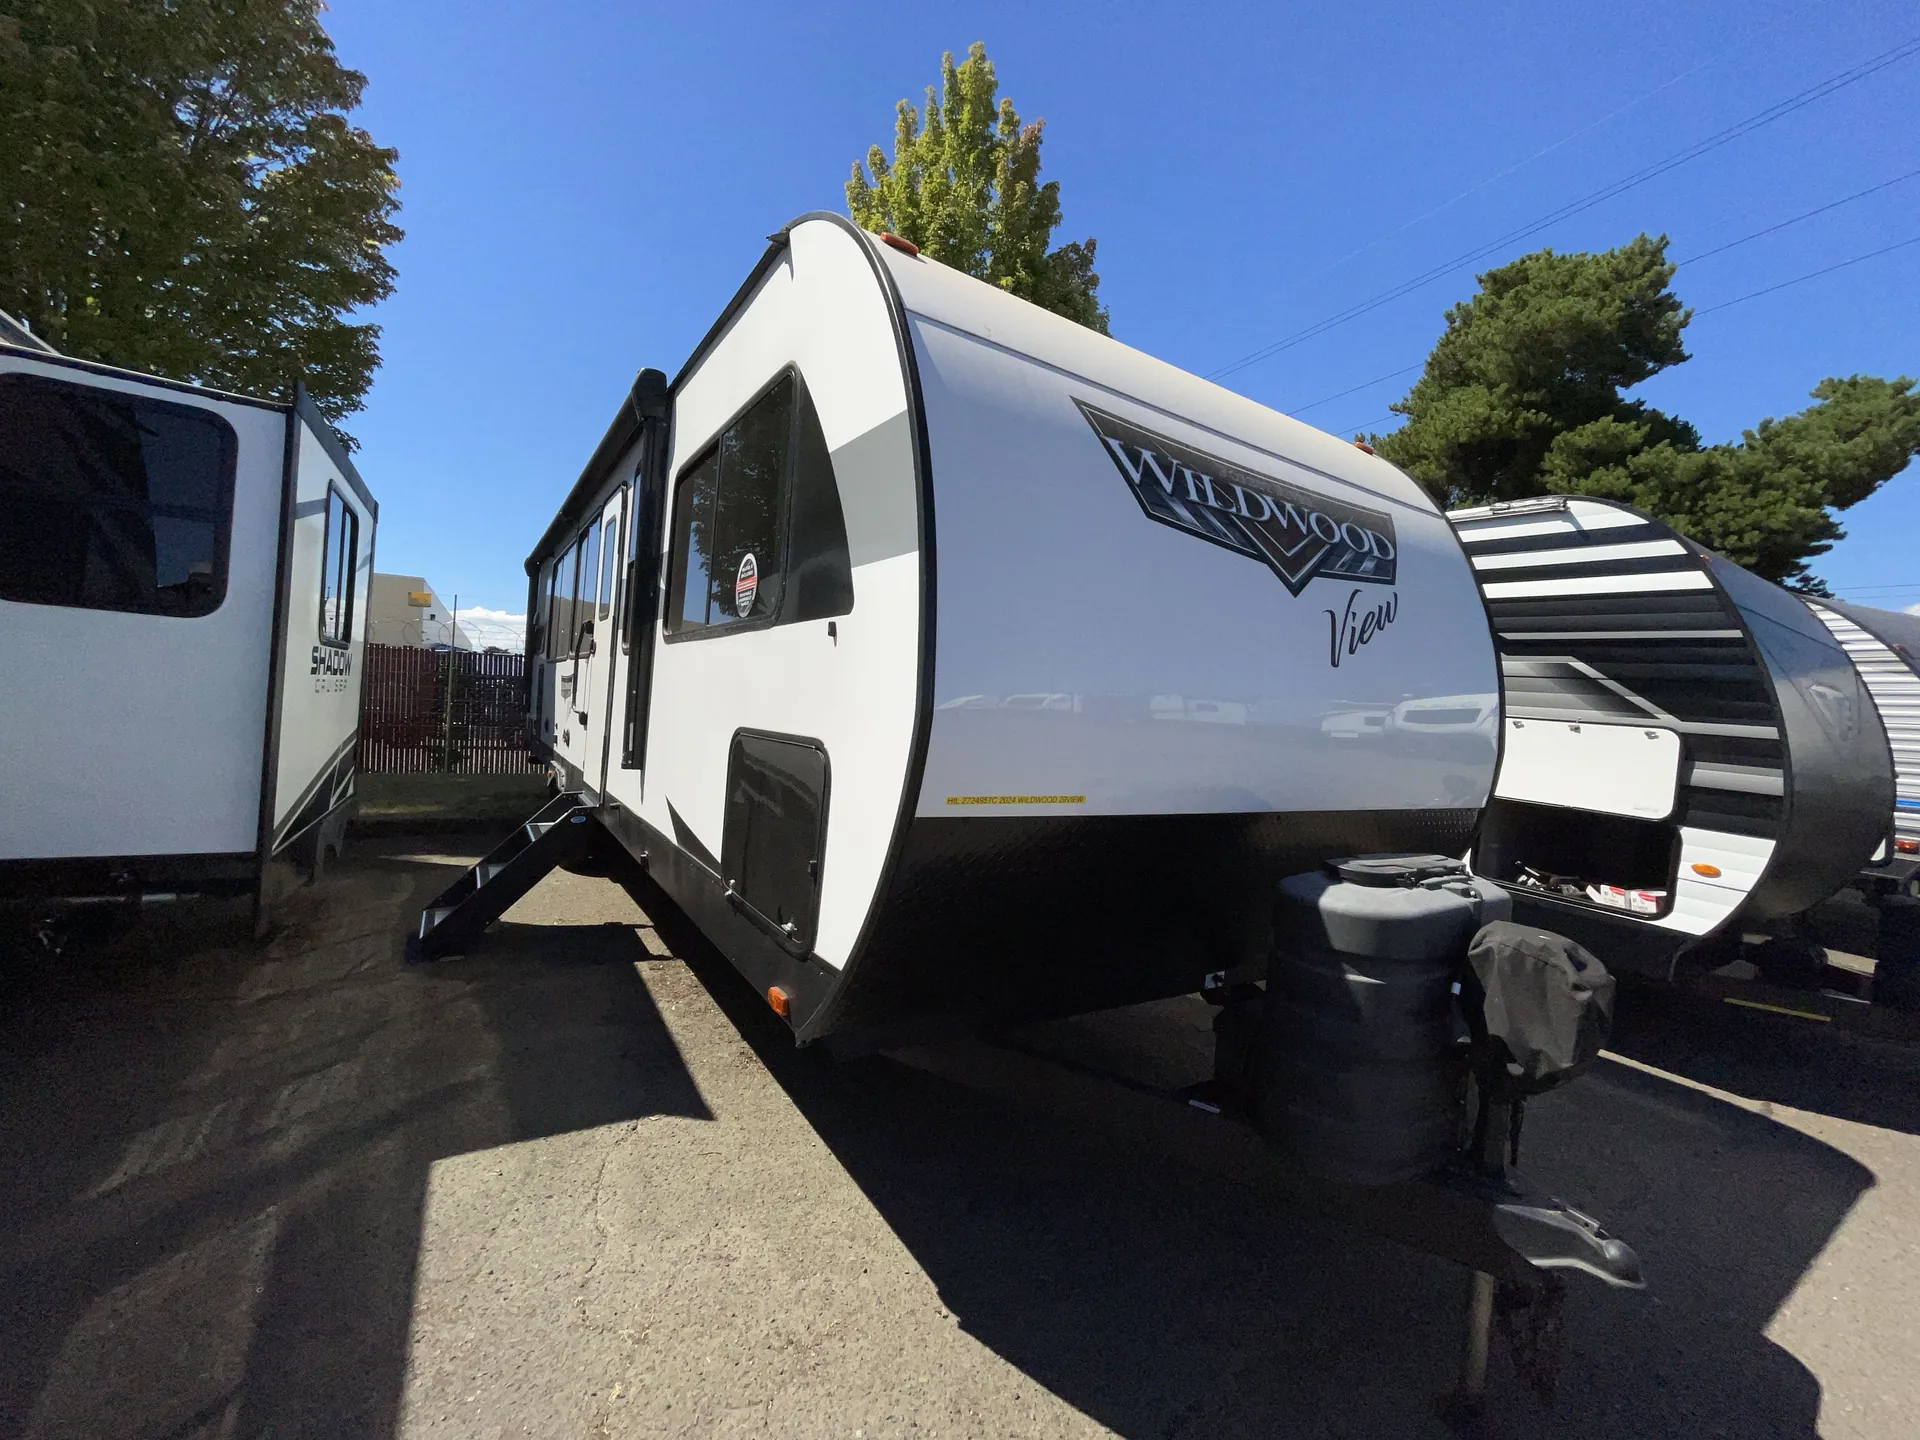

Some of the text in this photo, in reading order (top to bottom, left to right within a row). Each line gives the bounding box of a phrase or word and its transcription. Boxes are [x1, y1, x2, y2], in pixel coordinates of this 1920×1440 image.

[1102, 434, 1395, 561] WILDWOOD
[1322, 589, 1398, 667] View
[310, 646, 352, 676] SHADOW
[999, 796, 1016, 804] 2024
[1017, 796, 1058, 804] WILDWOOD
